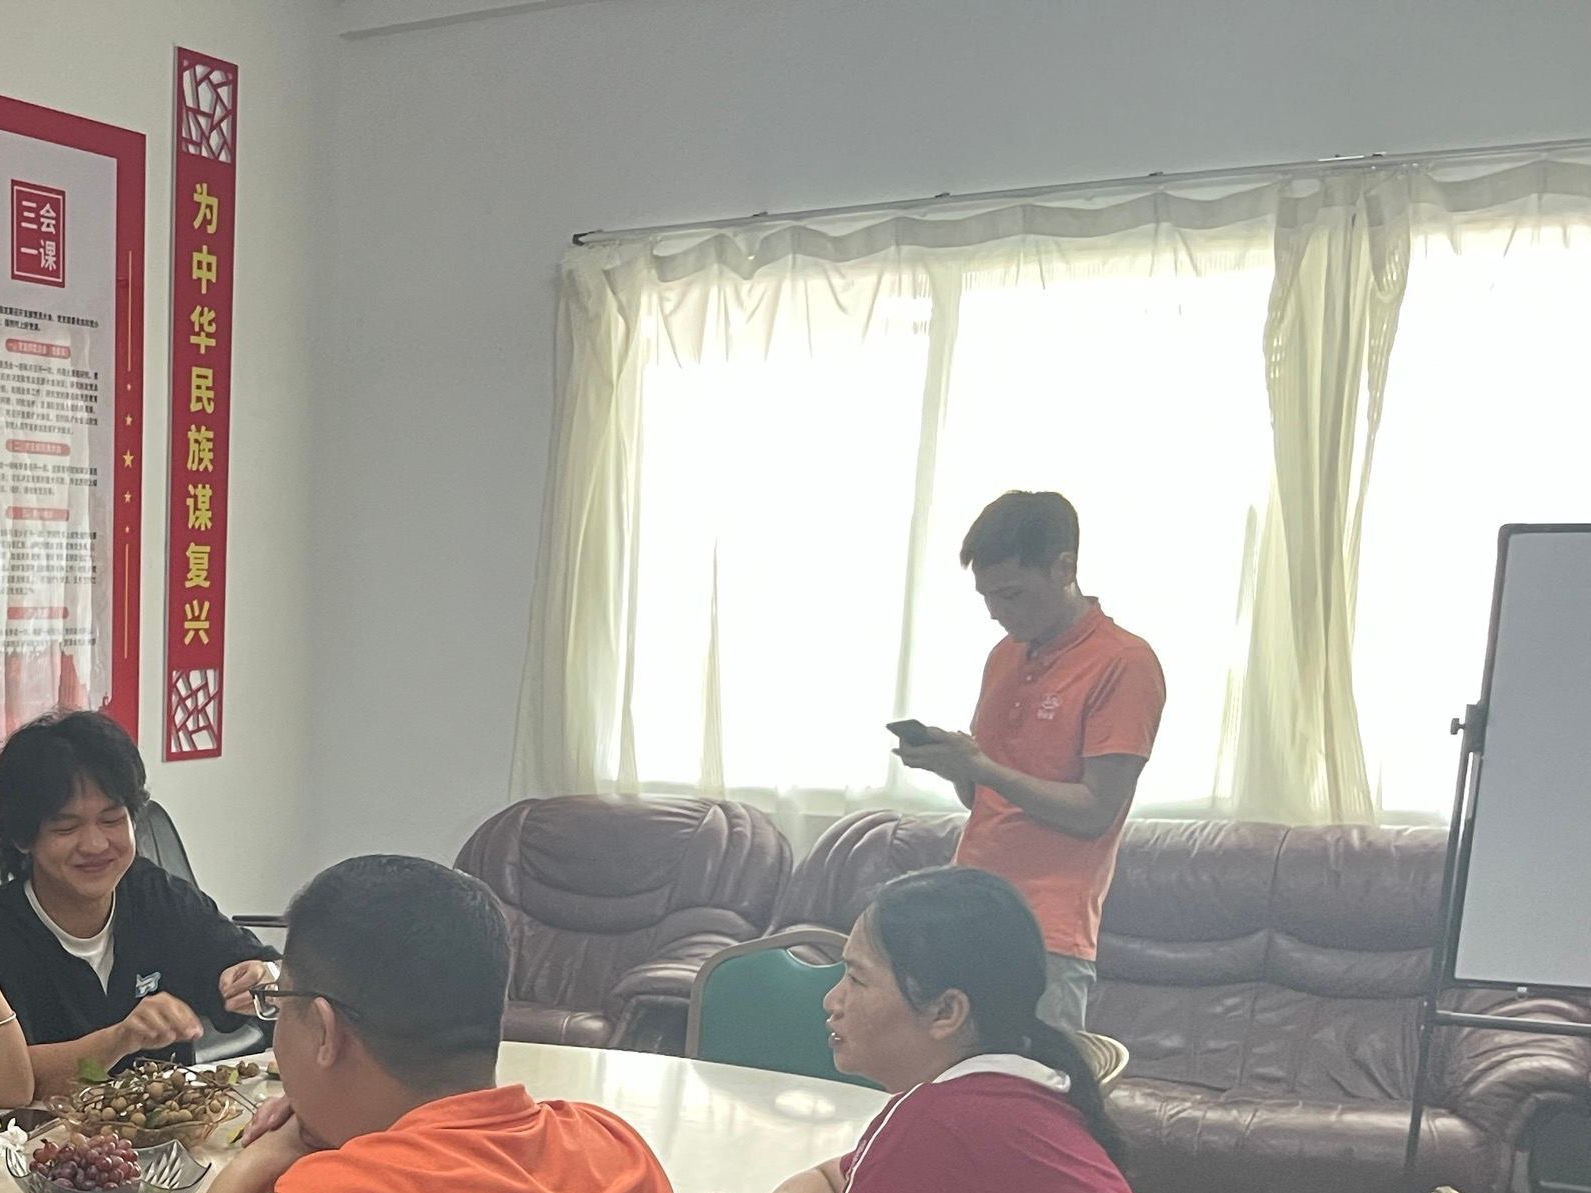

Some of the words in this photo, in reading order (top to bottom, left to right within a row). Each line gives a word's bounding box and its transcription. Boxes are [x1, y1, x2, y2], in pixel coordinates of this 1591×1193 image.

[20, 200, 56, 235] 三会
[20, 238, 56, 272] 一课
[184, 182, 219, 645] 为中华民族谋复兴
